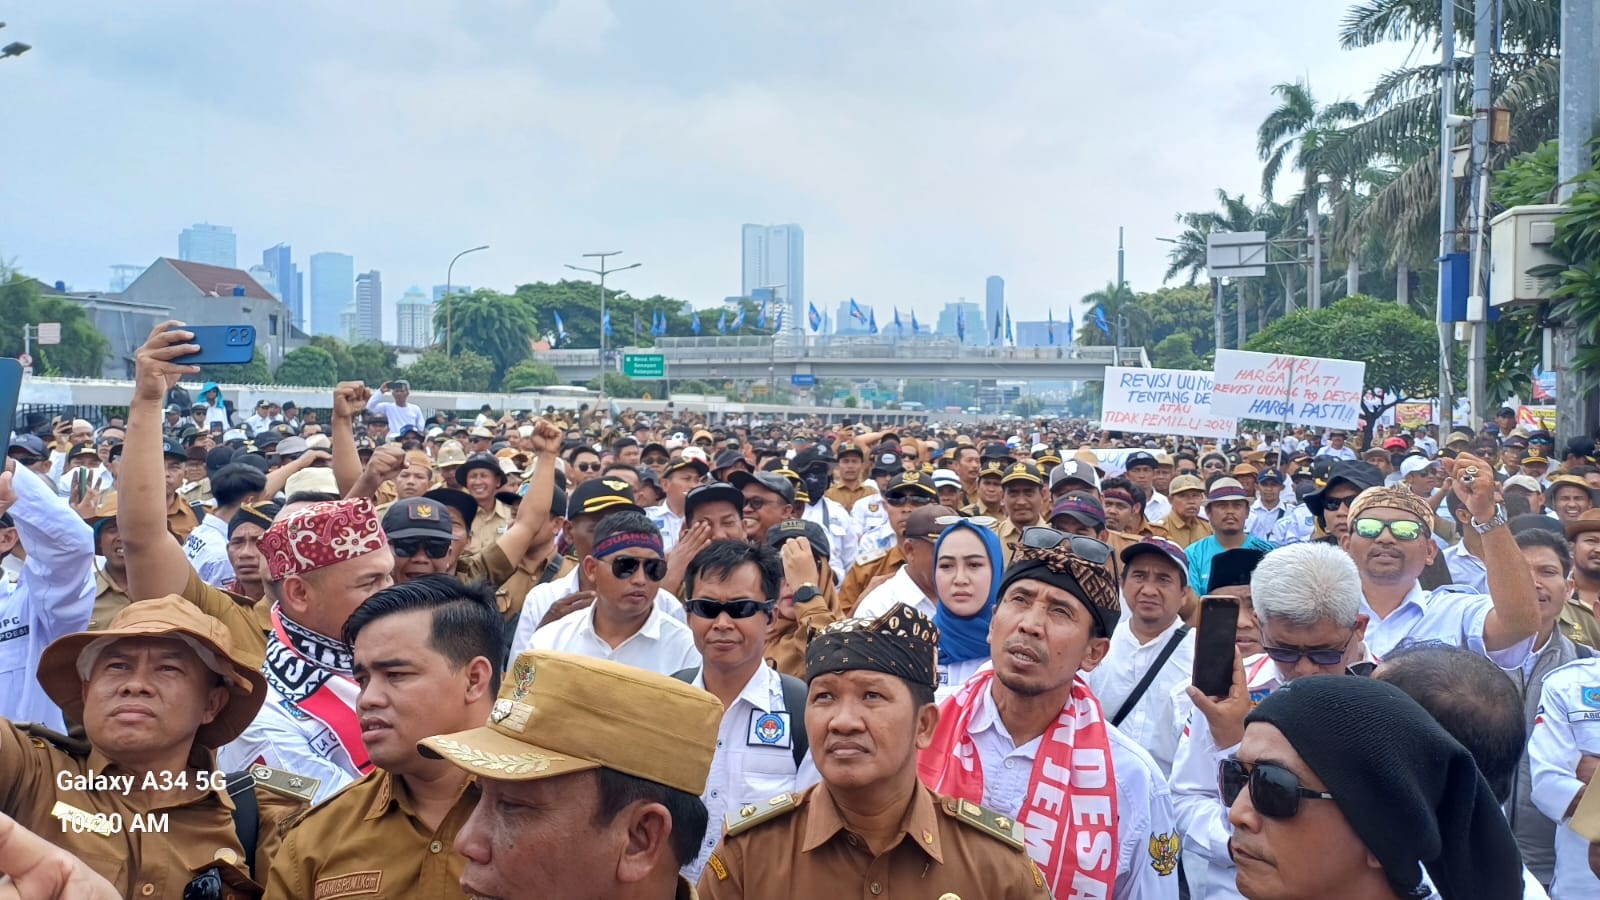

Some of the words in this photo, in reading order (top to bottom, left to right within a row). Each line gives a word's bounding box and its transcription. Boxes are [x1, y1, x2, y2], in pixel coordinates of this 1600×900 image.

[1267, 357, 1320, 375] NKRI
[1120, 373, 1172, 388] REVISI
[1177, 374, 1195, 390] UU
[1234, 369, 1285, 384] HARGA
[1293, 374, 1341, 387] MATI
[1213, 383, 1253, 395] REVISI
[1128, 391, 1190, 404] TENTANG
[1194, 391, 1212, 405] DE
[1159, 404, 1191, 414] ATAU
[1248, 399, 1294, 416] HARGA
[1104, 411, 1139, 424] TIDAK
[1141, 412, 1199, 430] PEMILU
[1204, 420, 1233, 433] 2024
[1023, 756, 1069, 868] JEM
